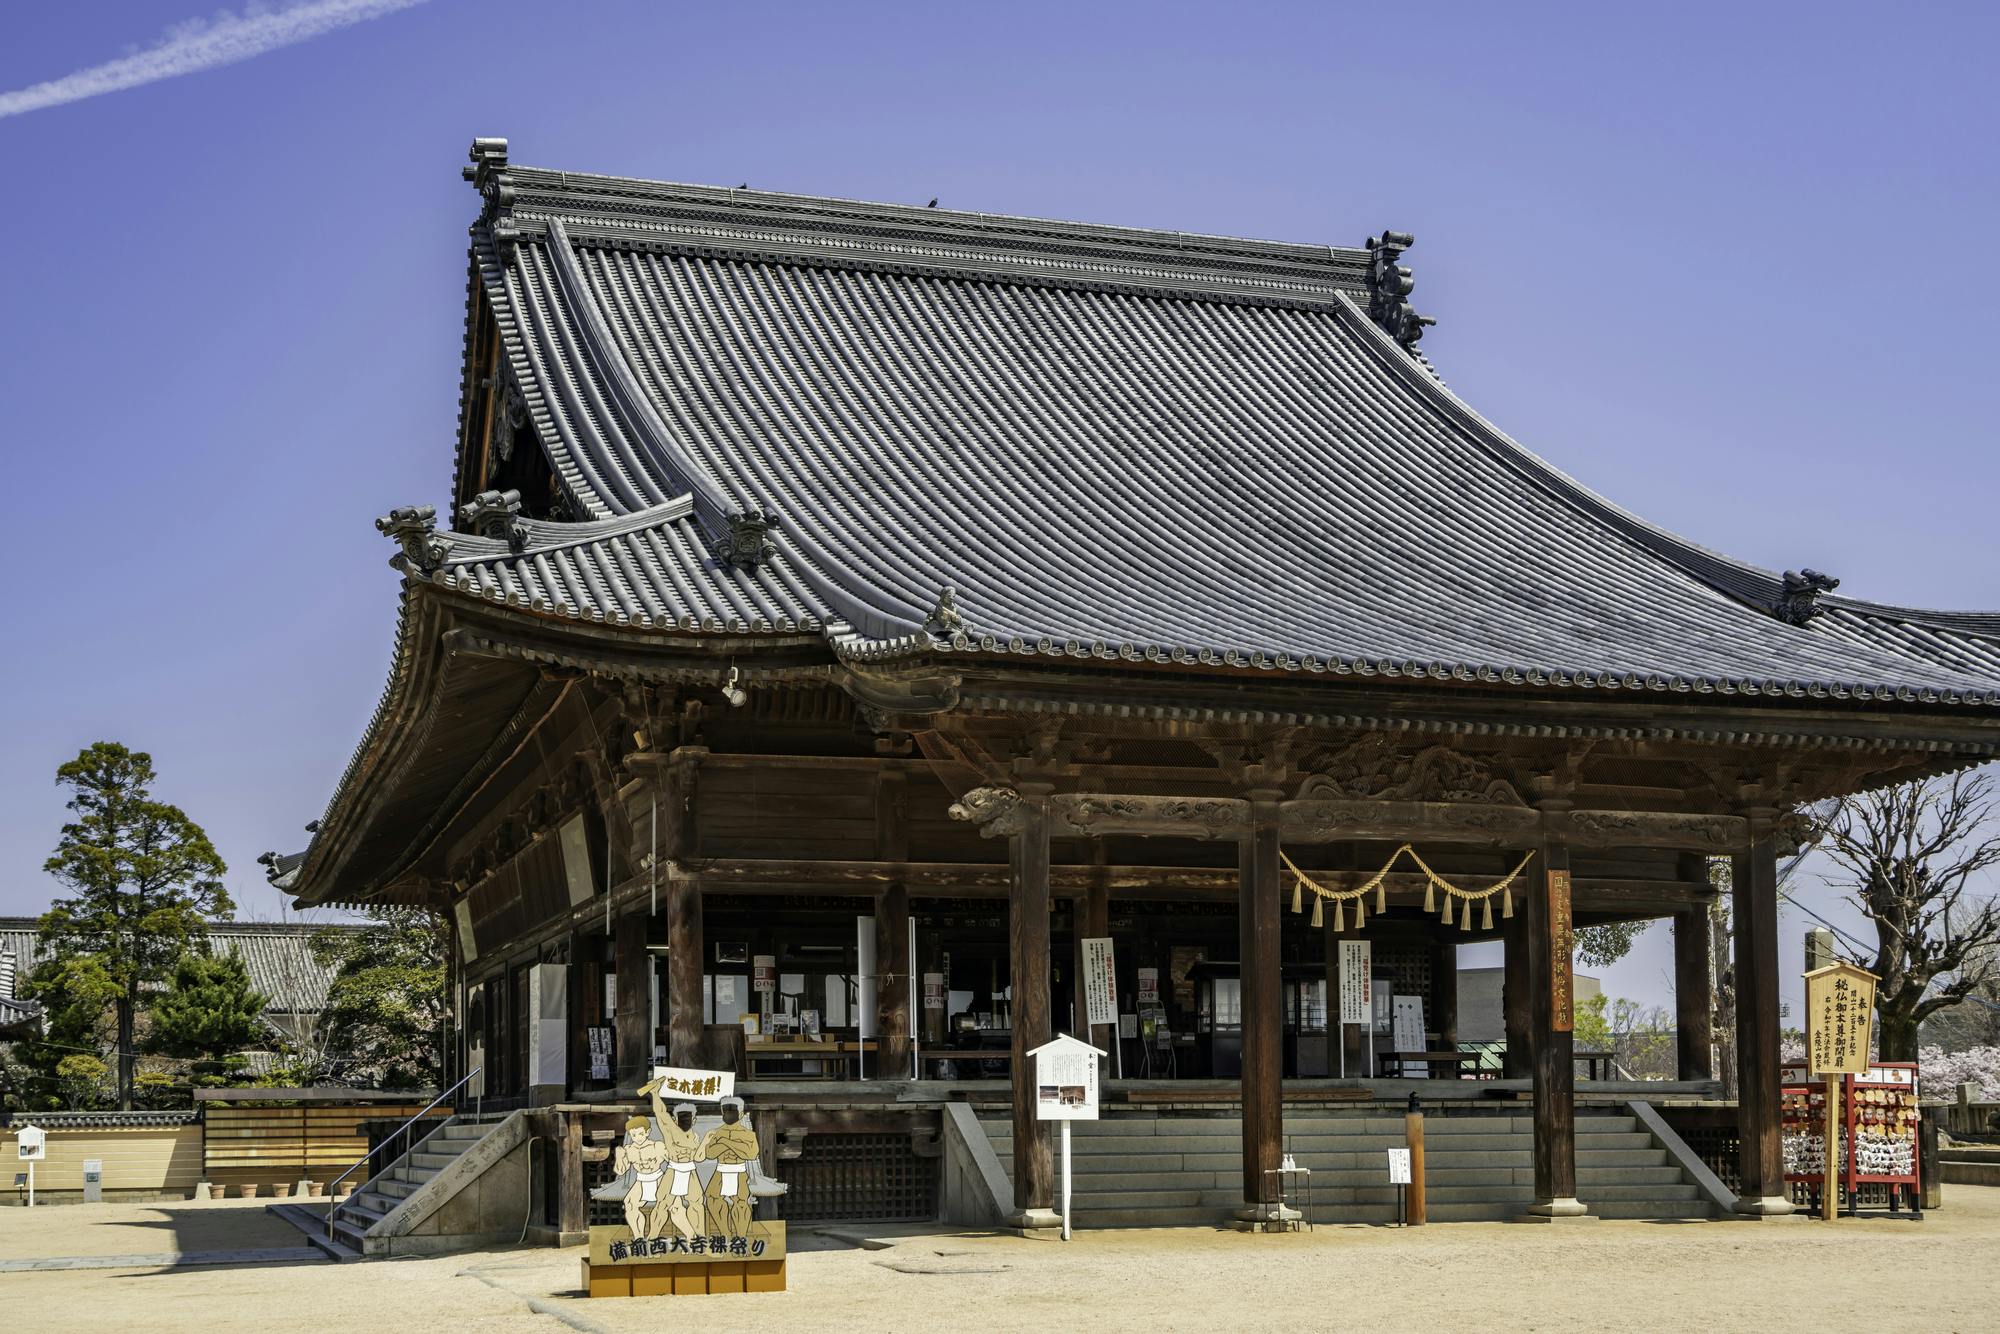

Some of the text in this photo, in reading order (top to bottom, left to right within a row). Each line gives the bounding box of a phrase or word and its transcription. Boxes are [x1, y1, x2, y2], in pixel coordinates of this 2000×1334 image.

[1834, 978, 1848, 1069] 秘仏御本尊御開扉
[1857, 997, 1868, 1026] 奉告
[609, 1235, 765, 1262] 備前西大寺裸祭り
